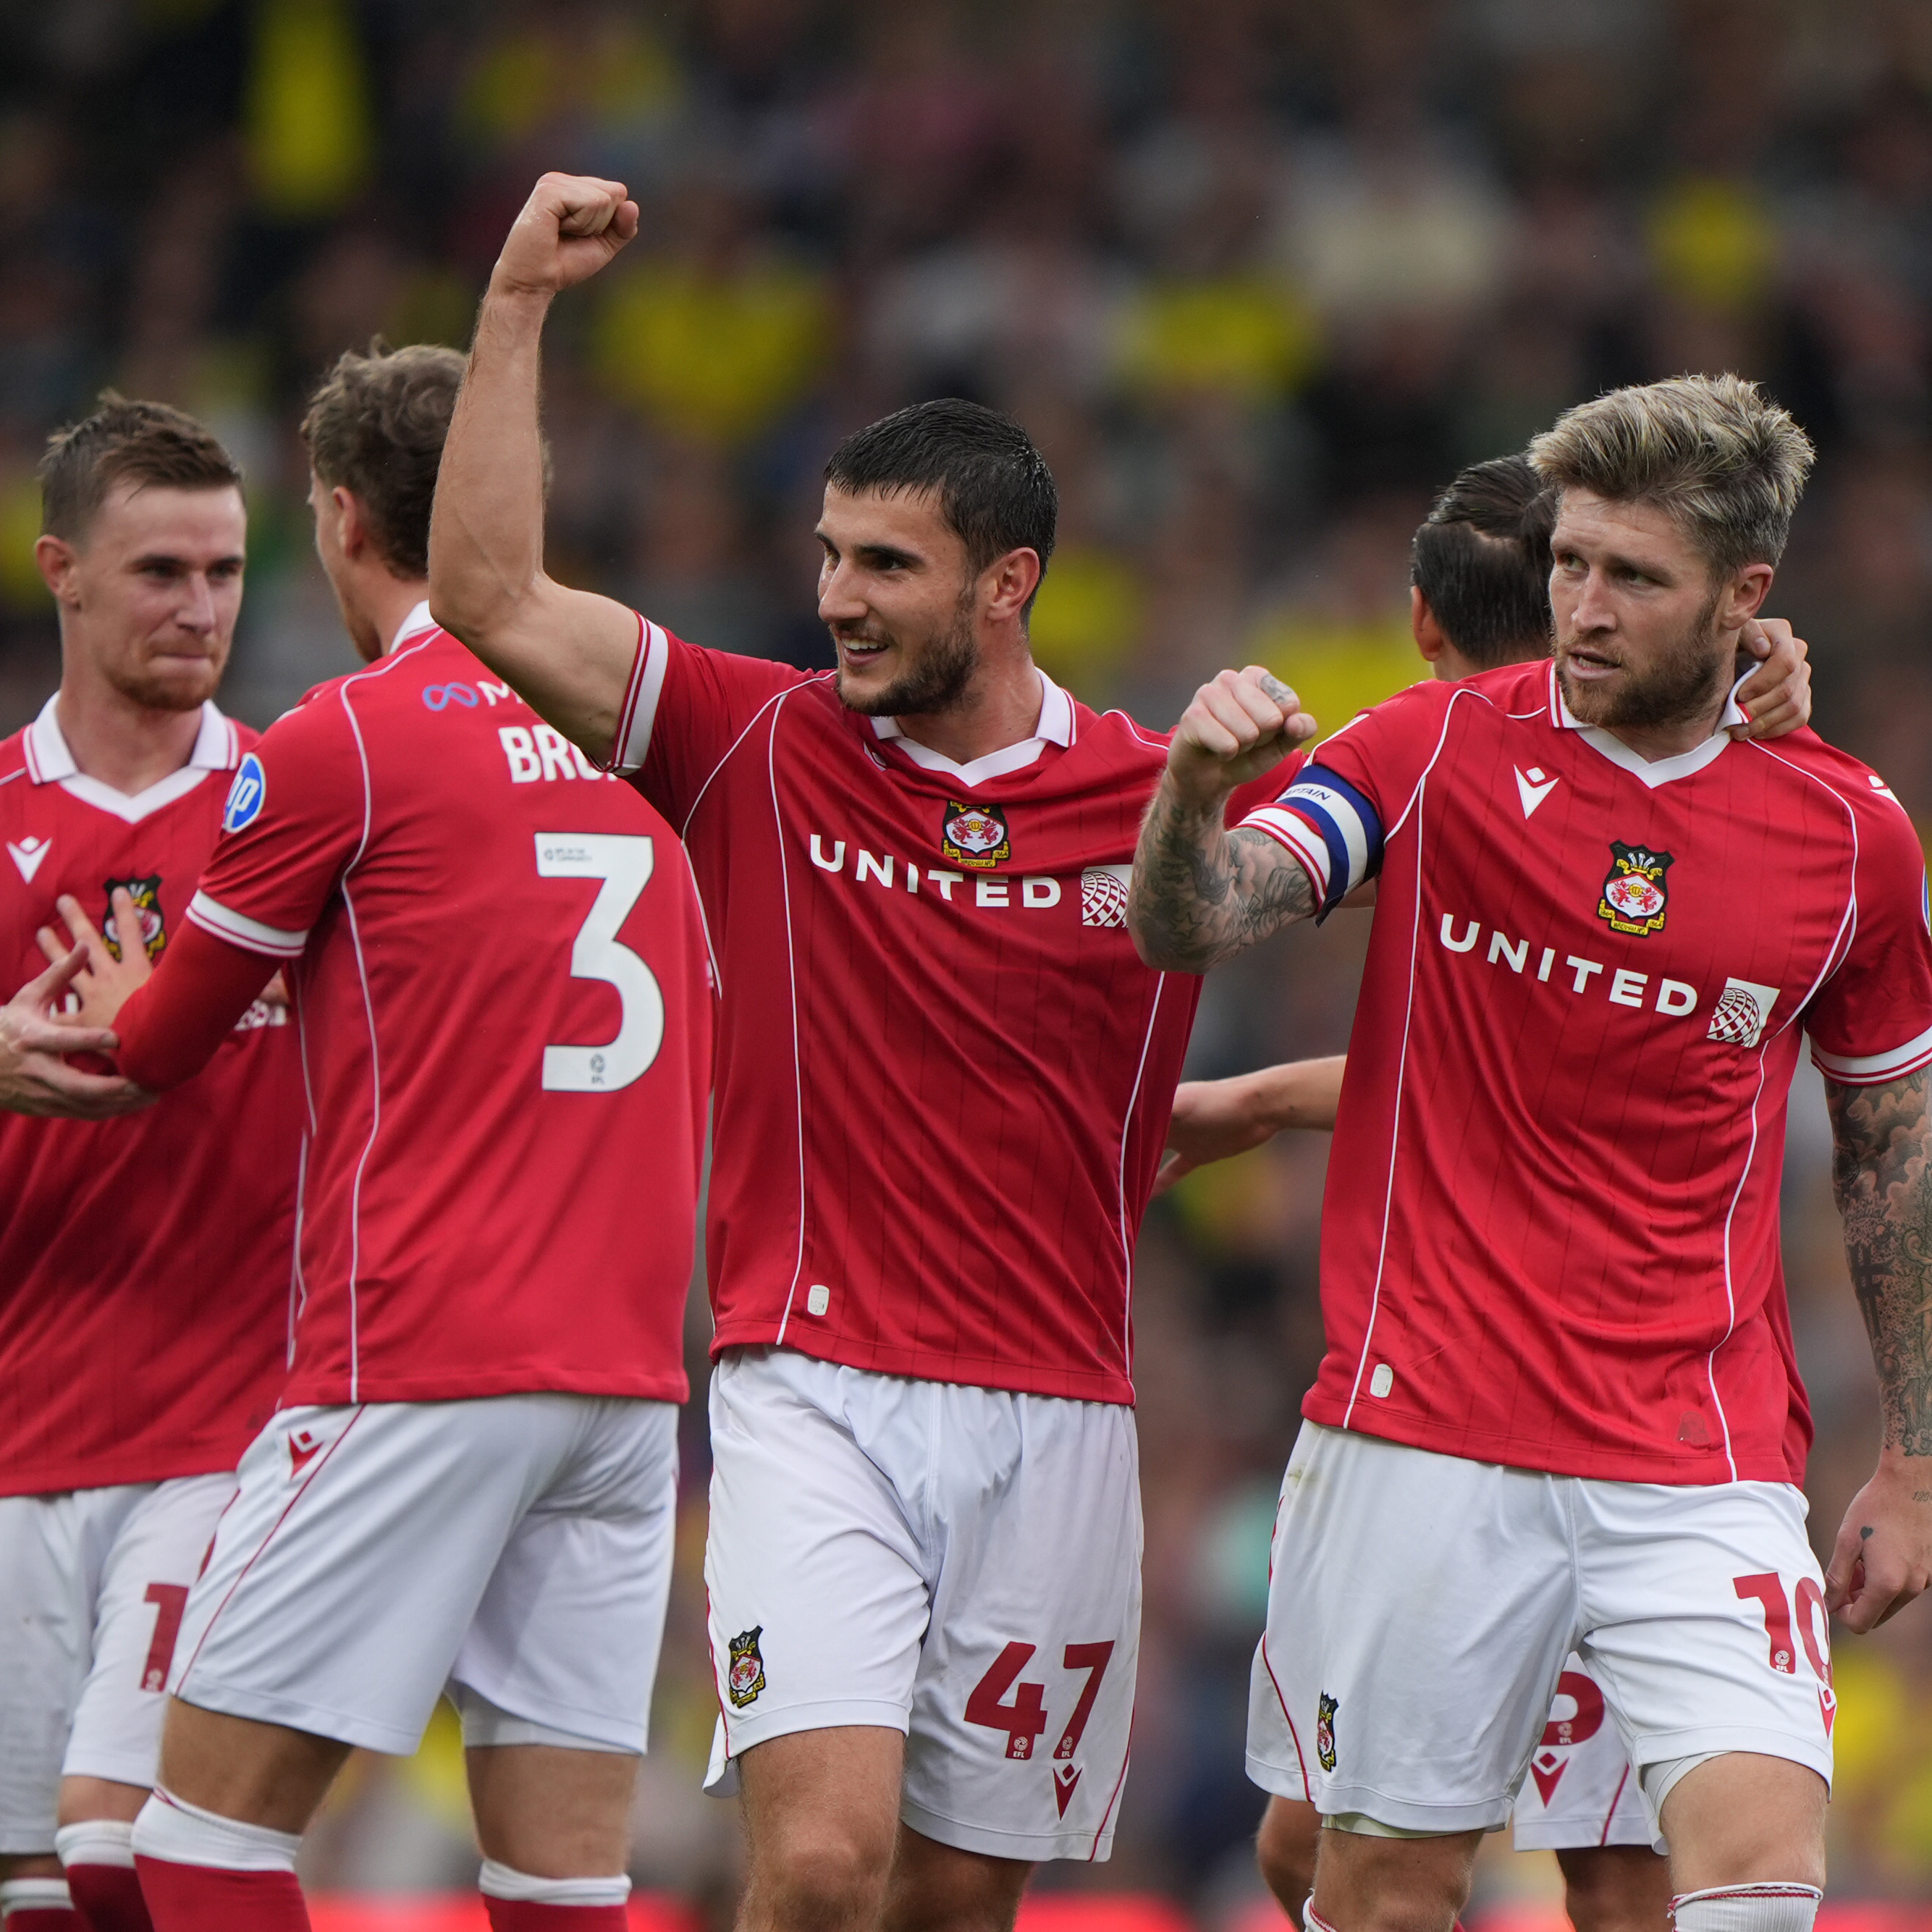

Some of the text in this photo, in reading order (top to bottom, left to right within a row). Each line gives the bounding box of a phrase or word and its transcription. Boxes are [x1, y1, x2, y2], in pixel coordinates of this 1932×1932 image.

[1284, 787, 1331, 801] APTAIN
[810, 834, 1062, 908] UNITED
[534, 832, 665, 1093] 3
[1440, 913, 1697, 1016] UNITED
[1733, 1572, 1834, 1690] 10
[963, 1640, 1115, 1760] 47
